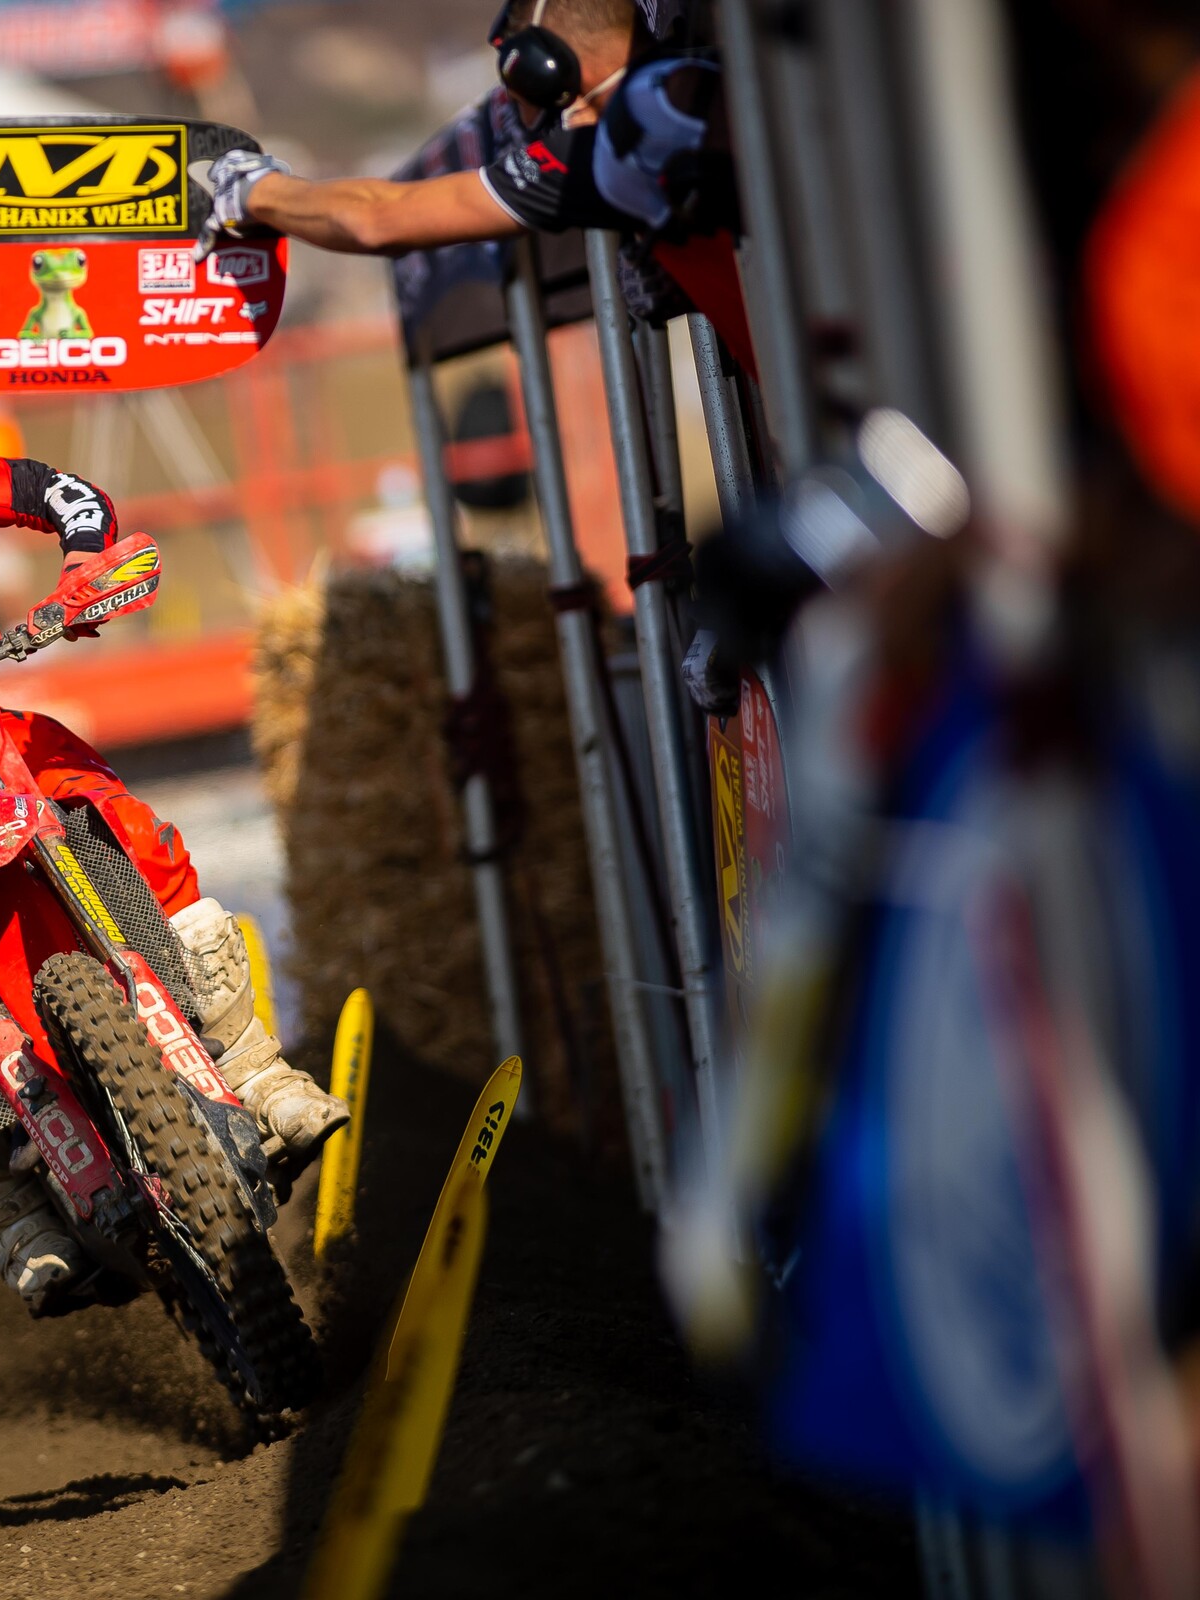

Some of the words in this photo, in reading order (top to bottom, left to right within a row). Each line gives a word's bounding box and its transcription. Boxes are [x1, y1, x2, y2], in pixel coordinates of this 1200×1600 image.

[91, 195, 178, 226] WEAR
[139, 297, 235, 325] SHIFT
[8, 370, 110, 384] HONDA
[85, 582, 149, 620] CYCRA
[56, 845, 127, 943] Connection
[0, 1050, 94, 1174] GICO
[21, 1113, 69, 1184] DUNLOP
